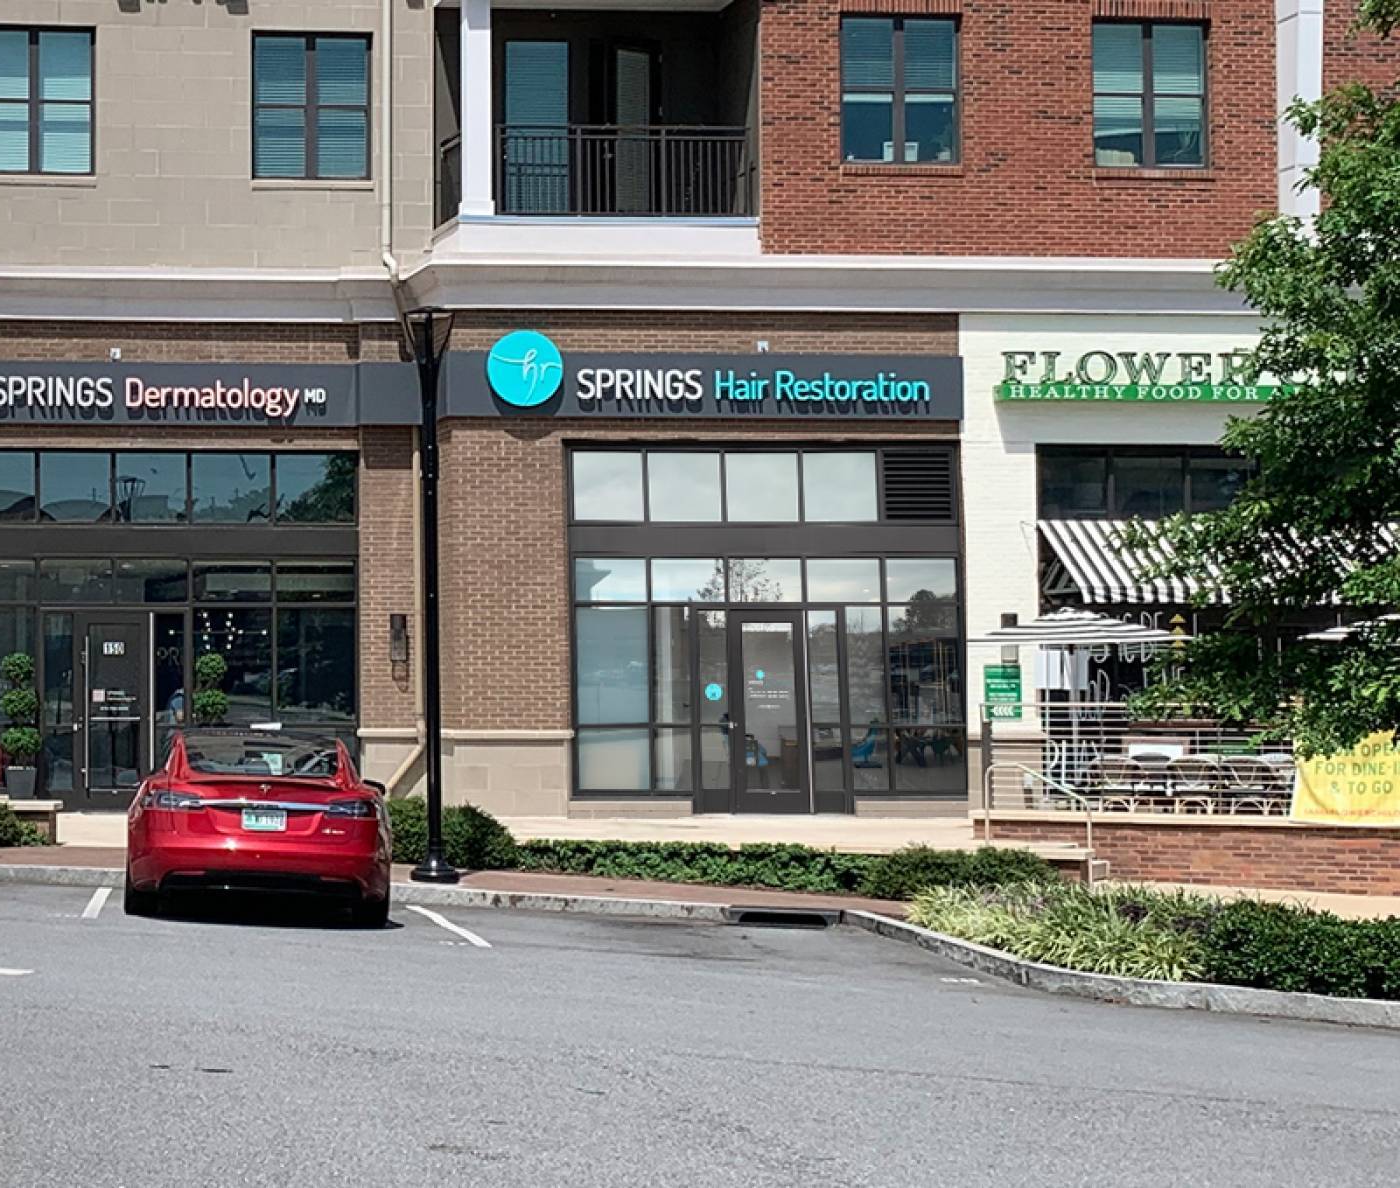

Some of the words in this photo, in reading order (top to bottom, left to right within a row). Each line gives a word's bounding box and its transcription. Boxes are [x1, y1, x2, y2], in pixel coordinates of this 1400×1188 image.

[576, 368, 703, 400] SPRINGS
[714, 370, 770, 400] Hair
[775, 370, 930, 401] Restoration
[125, 377, 300, 418] Dermatology
[304, 388, 327, 403] MD
[1009, 386, 1127, 399] HEALTHY
[1137, 386, 1202, 399] FOOD
[1212, 386, 1259, 400] FOR
[1361, 743, 1398, 758] OPE
[1315, 761, 1347, 776] FOR
[1352, 762, 1400, 776] DINE-I
[1348, 781, 1367, 795] TO
[1372, 780, 1394, 795] GO
